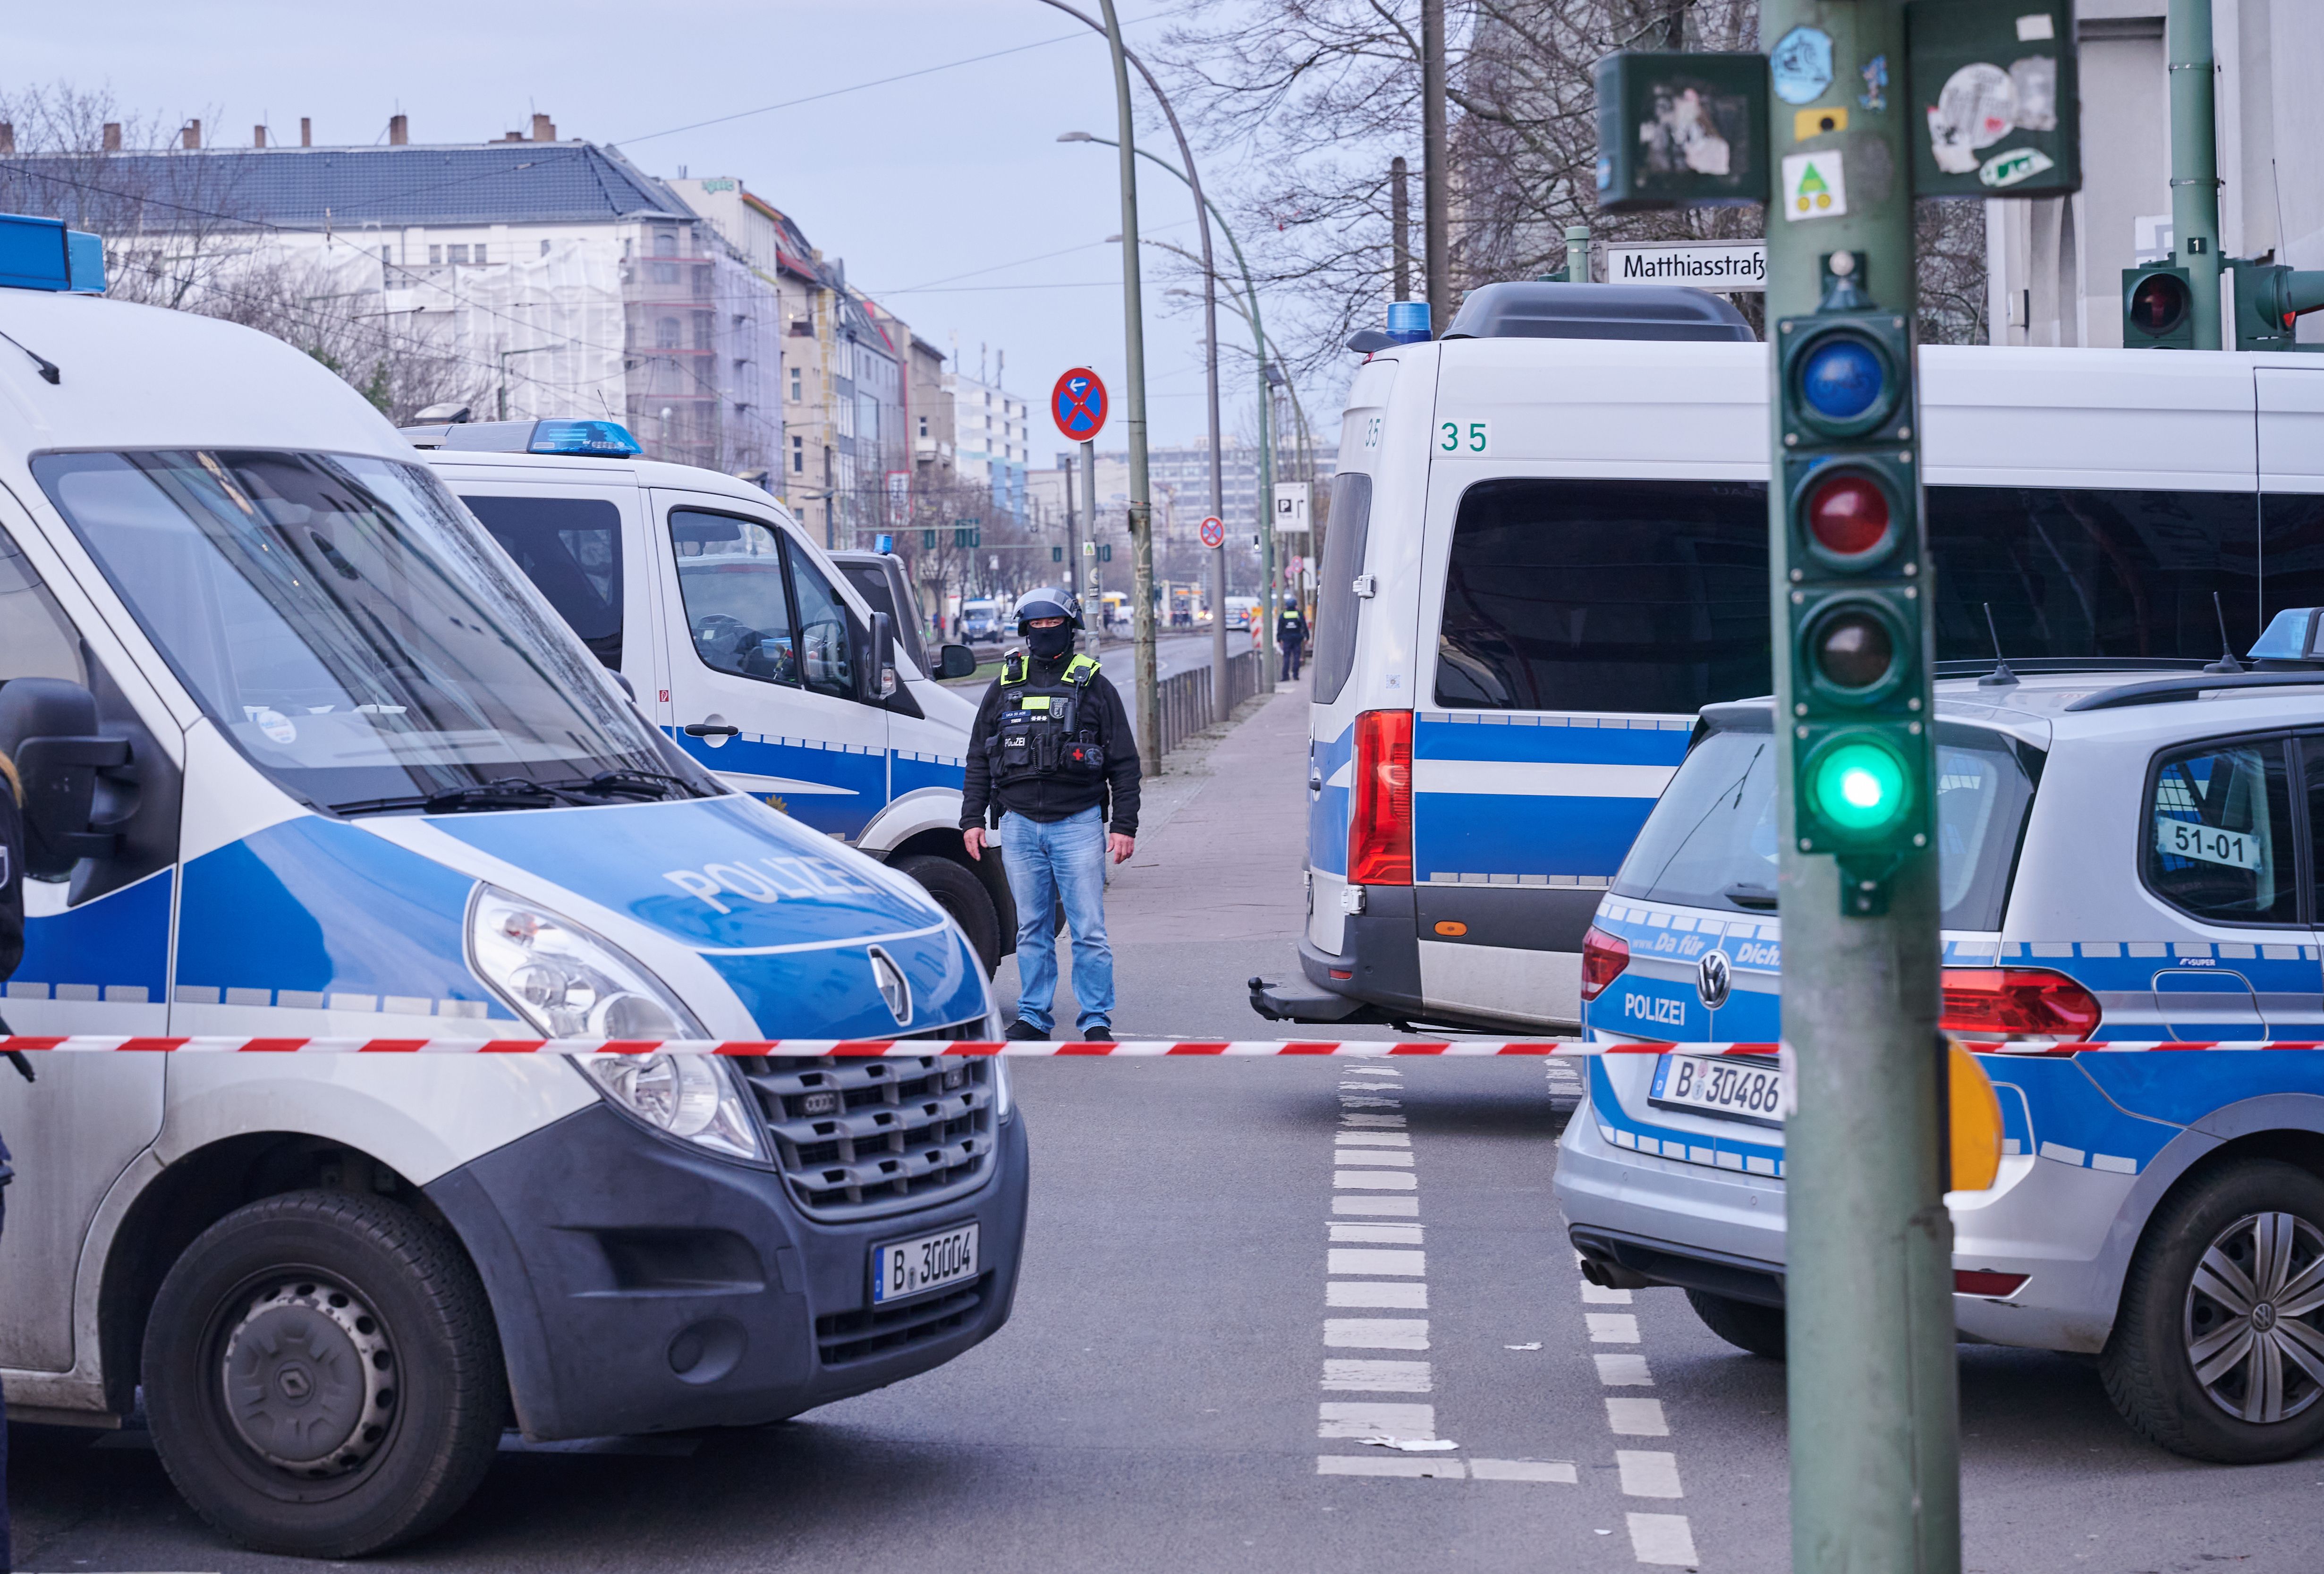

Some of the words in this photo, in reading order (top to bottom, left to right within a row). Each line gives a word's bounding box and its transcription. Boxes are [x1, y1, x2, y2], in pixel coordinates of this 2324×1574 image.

[1624, 252, 1766, 280] Matthiasstraß
[2175, 826, 2243, 863] 51-01
[1625, 992, 1685, 1026] POLIZEI
[1705, 1066, 1779, 1112] 30486
[921, 1231, 971, 1284] 30004
